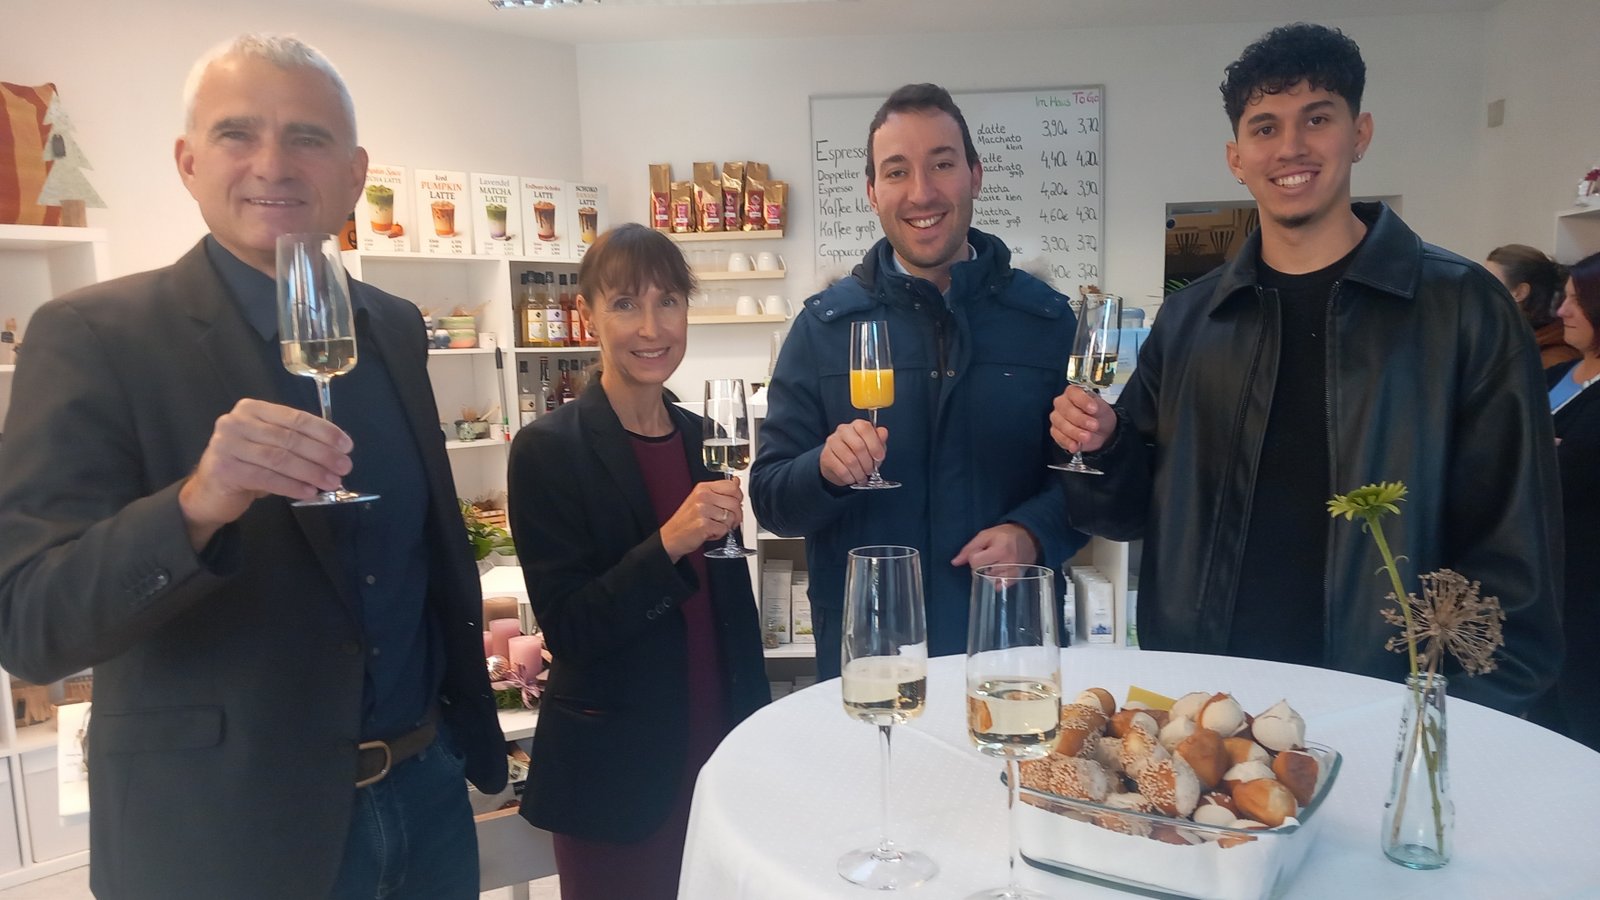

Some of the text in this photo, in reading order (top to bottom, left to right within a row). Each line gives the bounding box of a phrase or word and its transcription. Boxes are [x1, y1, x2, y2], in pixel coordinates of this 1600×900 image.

[983, 162, 1021, 172] acchiato
[421, 181, 462, 191] PUMPKIN
[479, 178, 510, 187] Lavendel
[479, 187, 512, 196] MATCHA
[981, 184, 1010, 194] atcha
[429, 191, 456, 200] LATTE
[485, 195, 508, 204] LATTE
[533, 191, 554, 199] LATTE
[579, 199, 597, 207] LATTE
[819, 197, 873, 218] Kaffee klei
[820, 221, 852, 240] Kaffee
[818, 243, 868, 264] Cappuccin
